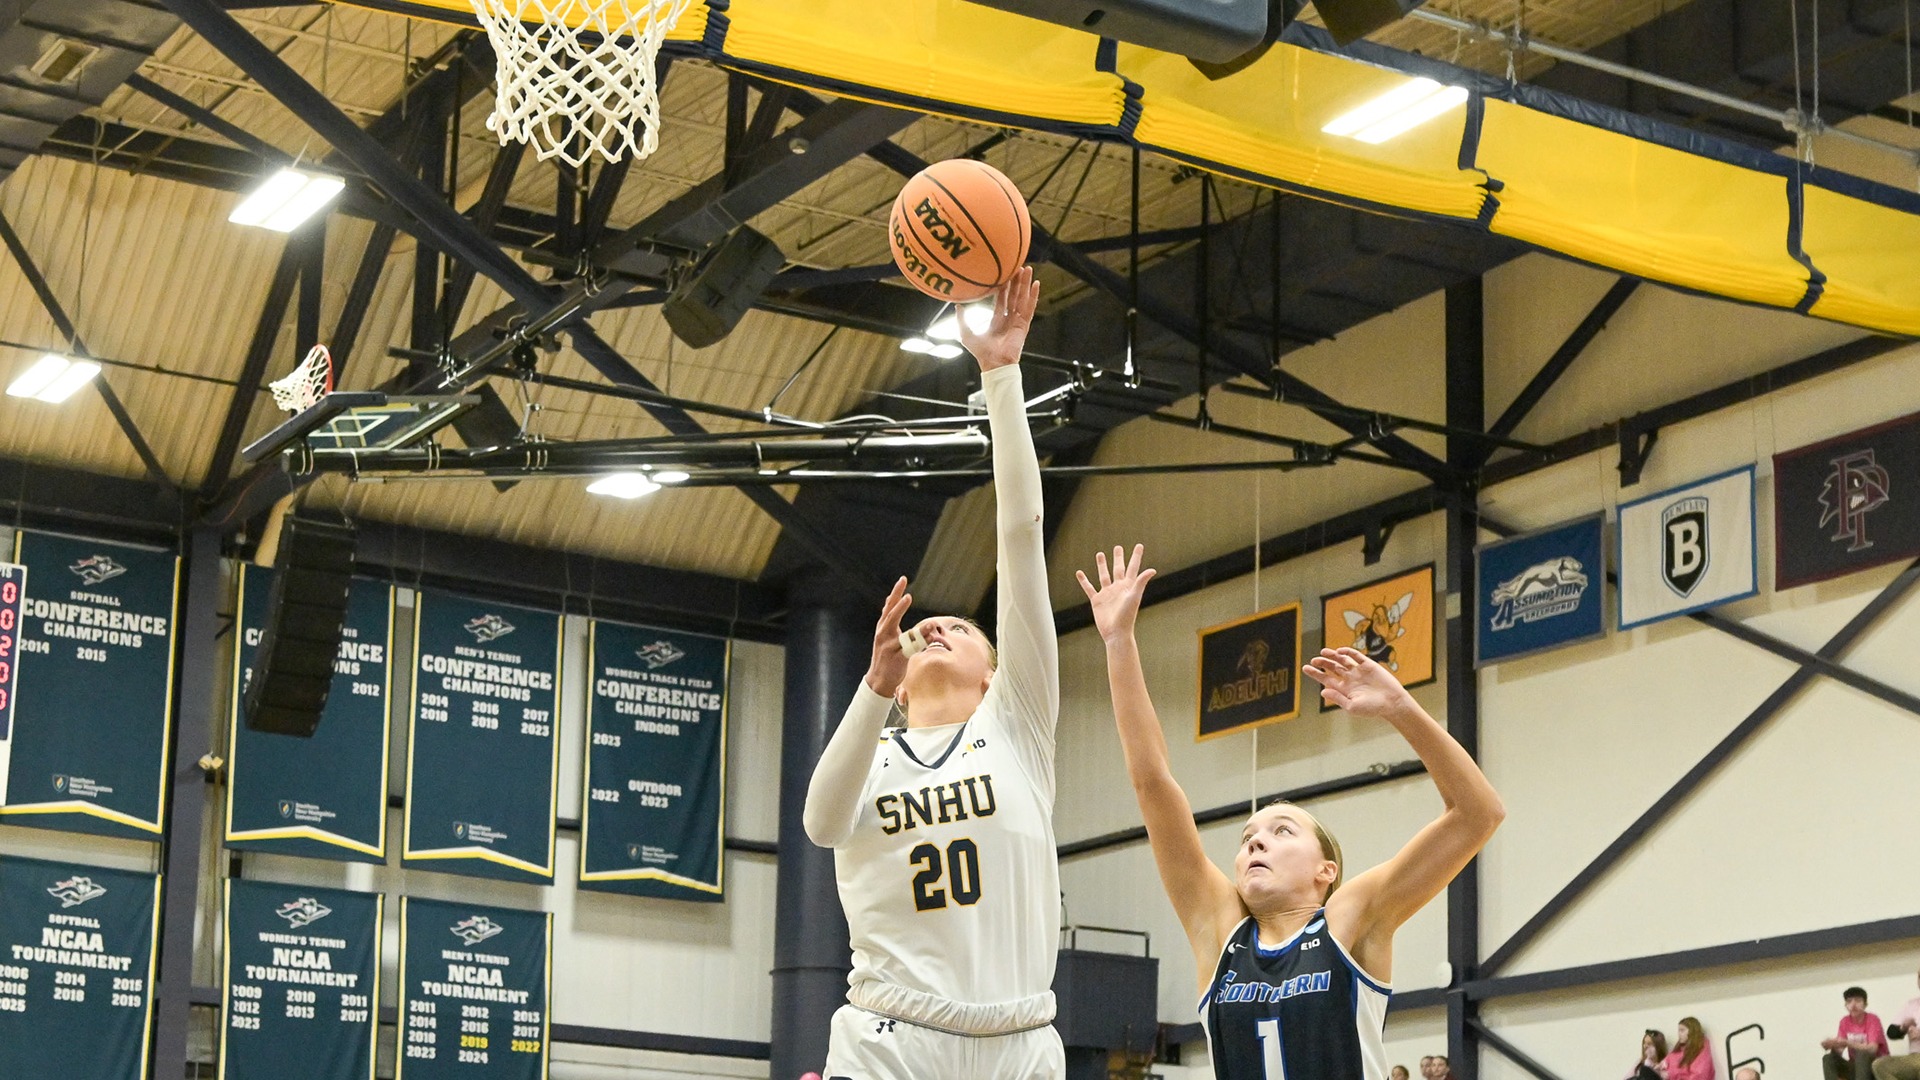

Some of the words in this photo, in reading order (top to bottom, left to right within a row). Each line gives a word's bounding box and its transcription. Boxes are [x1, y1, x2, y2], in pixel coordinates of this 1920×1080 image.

[914, 197, 971, 260] NCAA
[892, 215, 954, 295] Wilson
[1669, 520, 1702, 578] B
[0, 567, 12, 579] TS
[2, 582, 17, 604] 0
[70, 591, 121, 606] SOFTBALL
[23, 598, 167, 636] CONFERENCE
[43, 622, 143, 648] CHAMPIONS
[20, 639, 50, 654] 2014
[77, 647, 107, 662] 2015
[454, 646, 485, 659] MEN'S
[487, 650, 521, 665] TENNIS
[421, 654, 552, 691] CONFERENCE
[605, 667, 648, 681] WOMEN'S
[650, 673, 678, 685] TRACK
[687, 678, 712, 689] FIELD
[442, 677, 531, 702] CHAMPIONS
[597, 679, 720, 710] CONFERENCE
[1208, 667, 1289, 712] ADELPHI
[421, 693, 449, 708] 2014
[472, 701, 499, 716] 2016
[523, 708, 549, 723] 2017
[615, 701, 700, 723] CHAMPIONS
[471, 715, 499, 730] 2019
[520, 723, 550, 737] 2023
[635, 719, 679, 736] INDOOR
[593, 732, 621, 747] 2023
[591, 788, 620, 802] 2022
[641, 794, 669, 808] 2023
[628, 779, 682, 797] OUTDOOR
[875, 773, 997, 836] SNHU
[909, 837, 983, 913] 20
[49, 913, 100, 929] SOFTBALL
[42, 927, 104, 952] NCAA
[258, 932, 307, 945] WOMEN'S
[309, 936, 346, 949] TENNIS
[12, 945, 132, 971] TOURNAMENT
[273, 947, 331, 970] NCAA
[441, 949, 473, 962] MEN'S
[474, 953, 510, 966] TENNIS
[55, 970, 86, 986] 2014
[112, 977, 143, 992] 2015
[245, 964, 358, 988] TOURNAMENT
[448, 964, 503, 987] NCAA
[53, 986, 85, 1002] 2018
[111, 993, 141, 1008] 2019
[232, 984, 262, 999] 2009
[286, 989, 316, 1003] 2010
[341, 994, 367, 1008] 2011
[421, 981, 529, 1004] TOURNAMENT
[0, 997, 26, 1012] 025
[233, 1000, 260, 1015] 2012
[286, 1005, 315, 1019] 2013
[340, 1009, 368, 1023] 2017
[410, 1000, 436, 1014] 2011
[461, 1005, 489, 1019] 2012
[513, 1010, 540, 1024] 2013
[231, 1015, 260, 1030] 2023
[409, 1015, 437, 1029] 2014
[461, 1020, 489, 1034] 2016
[512, 1025, 540, 1038] 2017
[408, 1030, 436, 1044] 2018
[460, 1035, 489, 1048] 2019
[511, 1040, 541, 1053] 2022
[1255, 1017, 1289, 1080] 1
[406, 1045, 436, 1059] 2023
[458, 1050, 489, 1064] 2024
